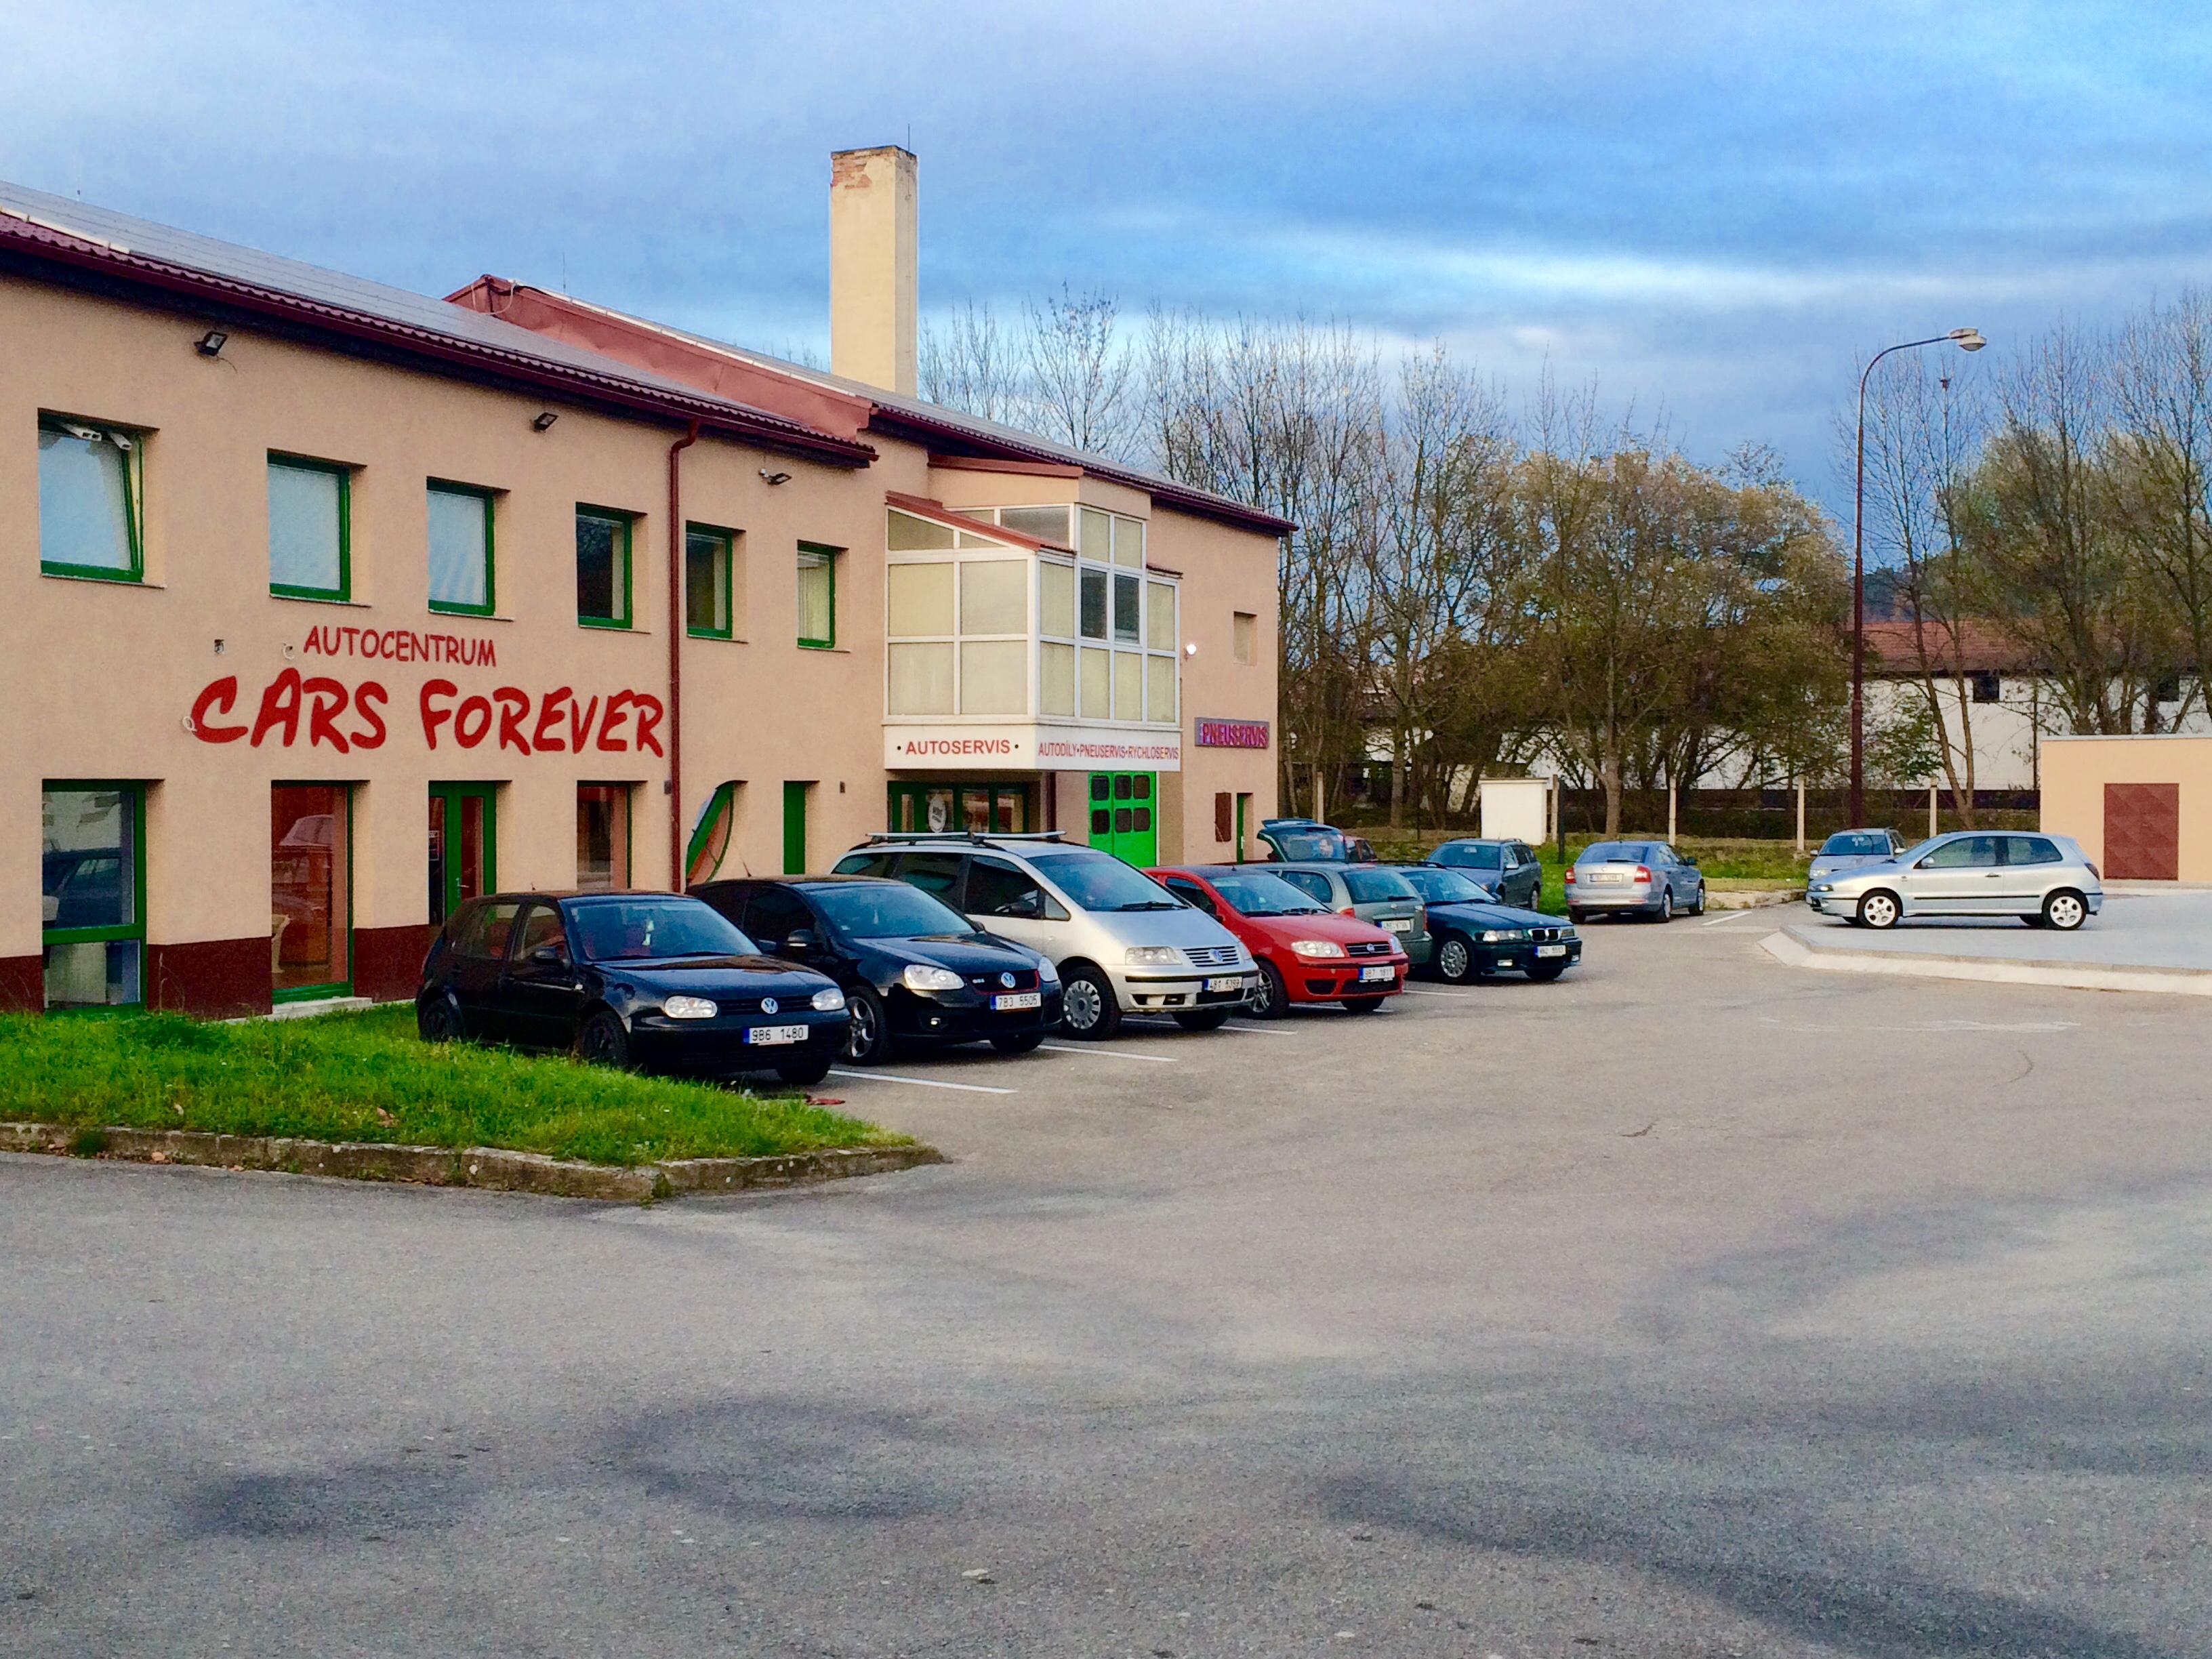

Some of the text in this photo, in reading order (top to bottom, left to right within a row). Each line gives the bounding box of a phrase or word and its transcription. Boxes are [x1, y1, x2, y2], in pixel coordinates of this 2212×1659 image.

[304, 626, 496, 667] AUTOCENTRUM
[191, 668, 664, 758] CARS FOREVER
[1200, 722, 1269, 747] PNEUSERVIS
[905, 740, 1010, 755] AUTOSERVIS
[998, 997, 1014, 1008] 7B3
[752, 1027, 804, 1041] 9B6 1480
